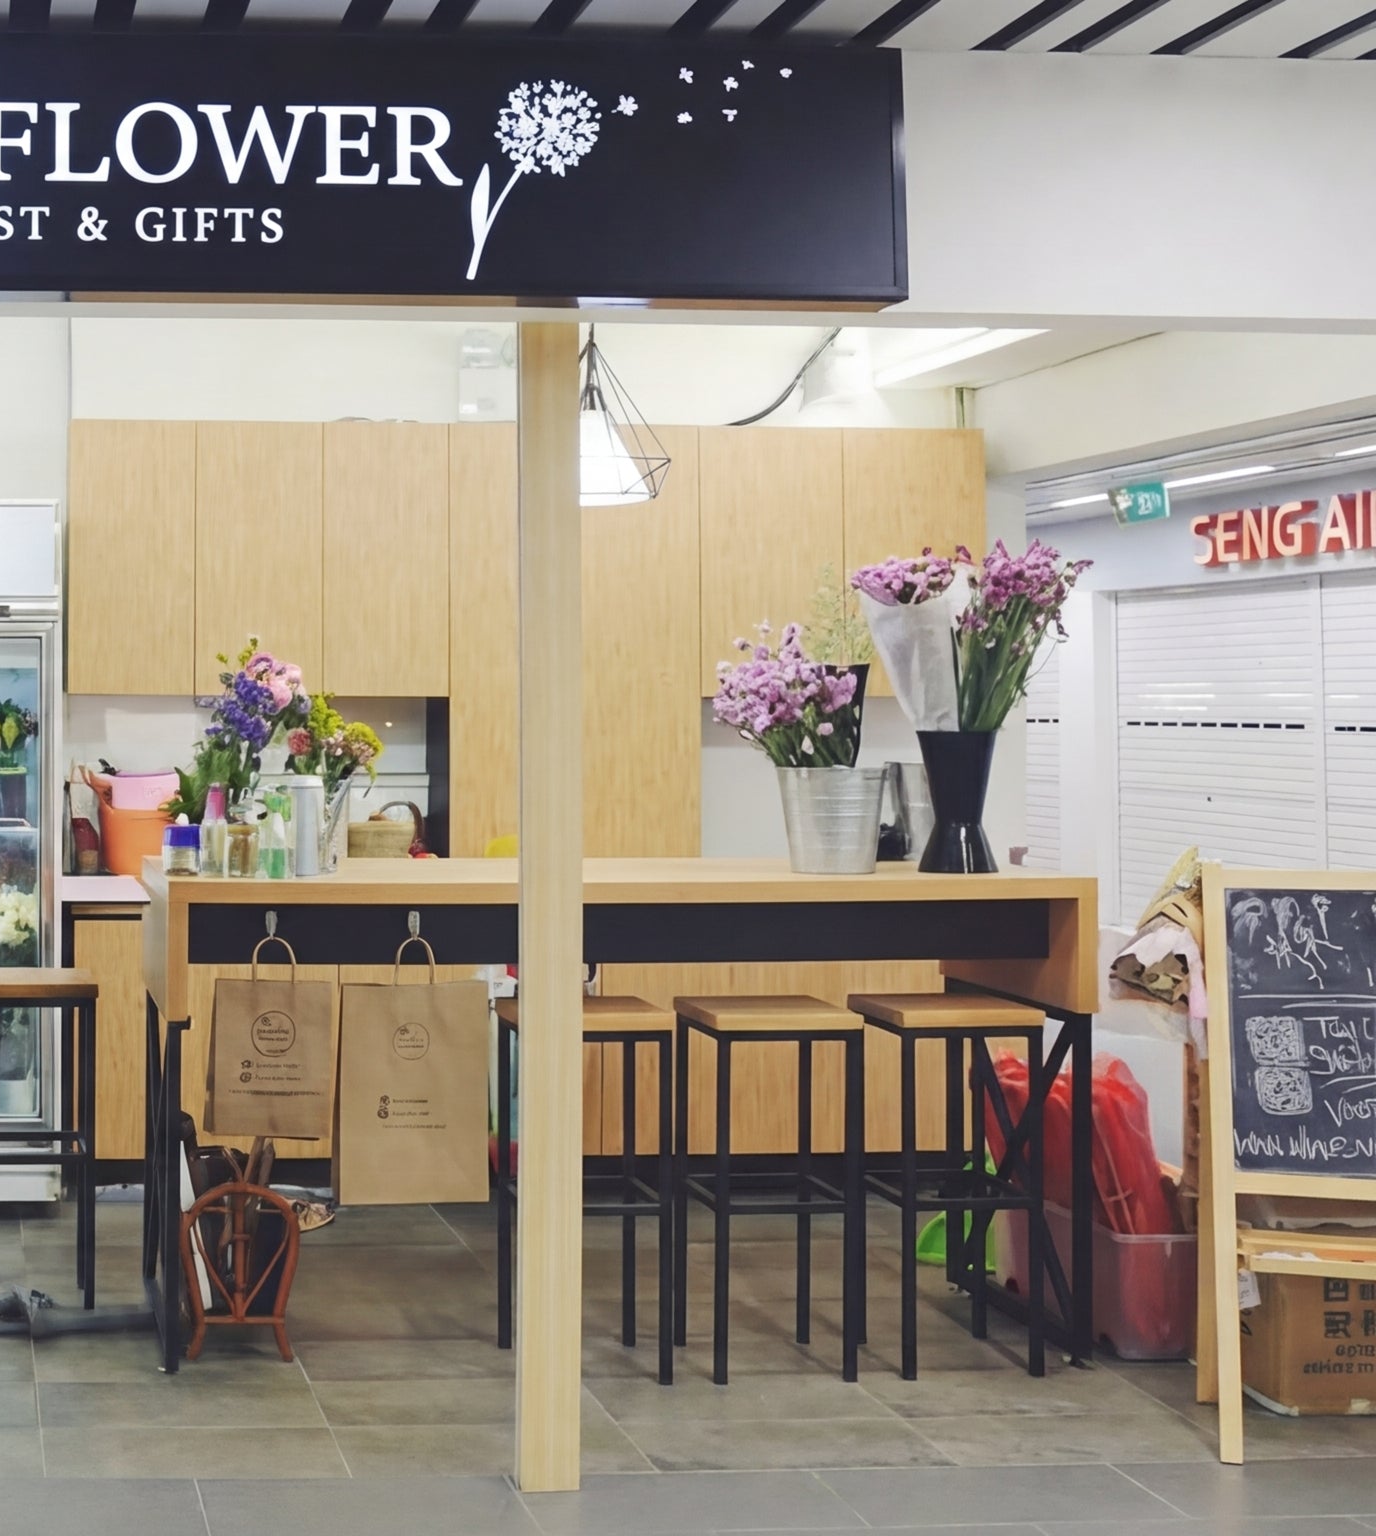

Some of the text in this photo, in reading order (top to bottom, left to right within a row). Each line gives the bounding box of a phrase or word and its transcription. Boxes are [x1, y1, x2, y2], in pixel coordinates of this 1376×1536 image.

[76, 206, 109, 242] &
[134, 206, 284, 244] GIFTS
[1190, 490, 1376, 566] SENG AI
